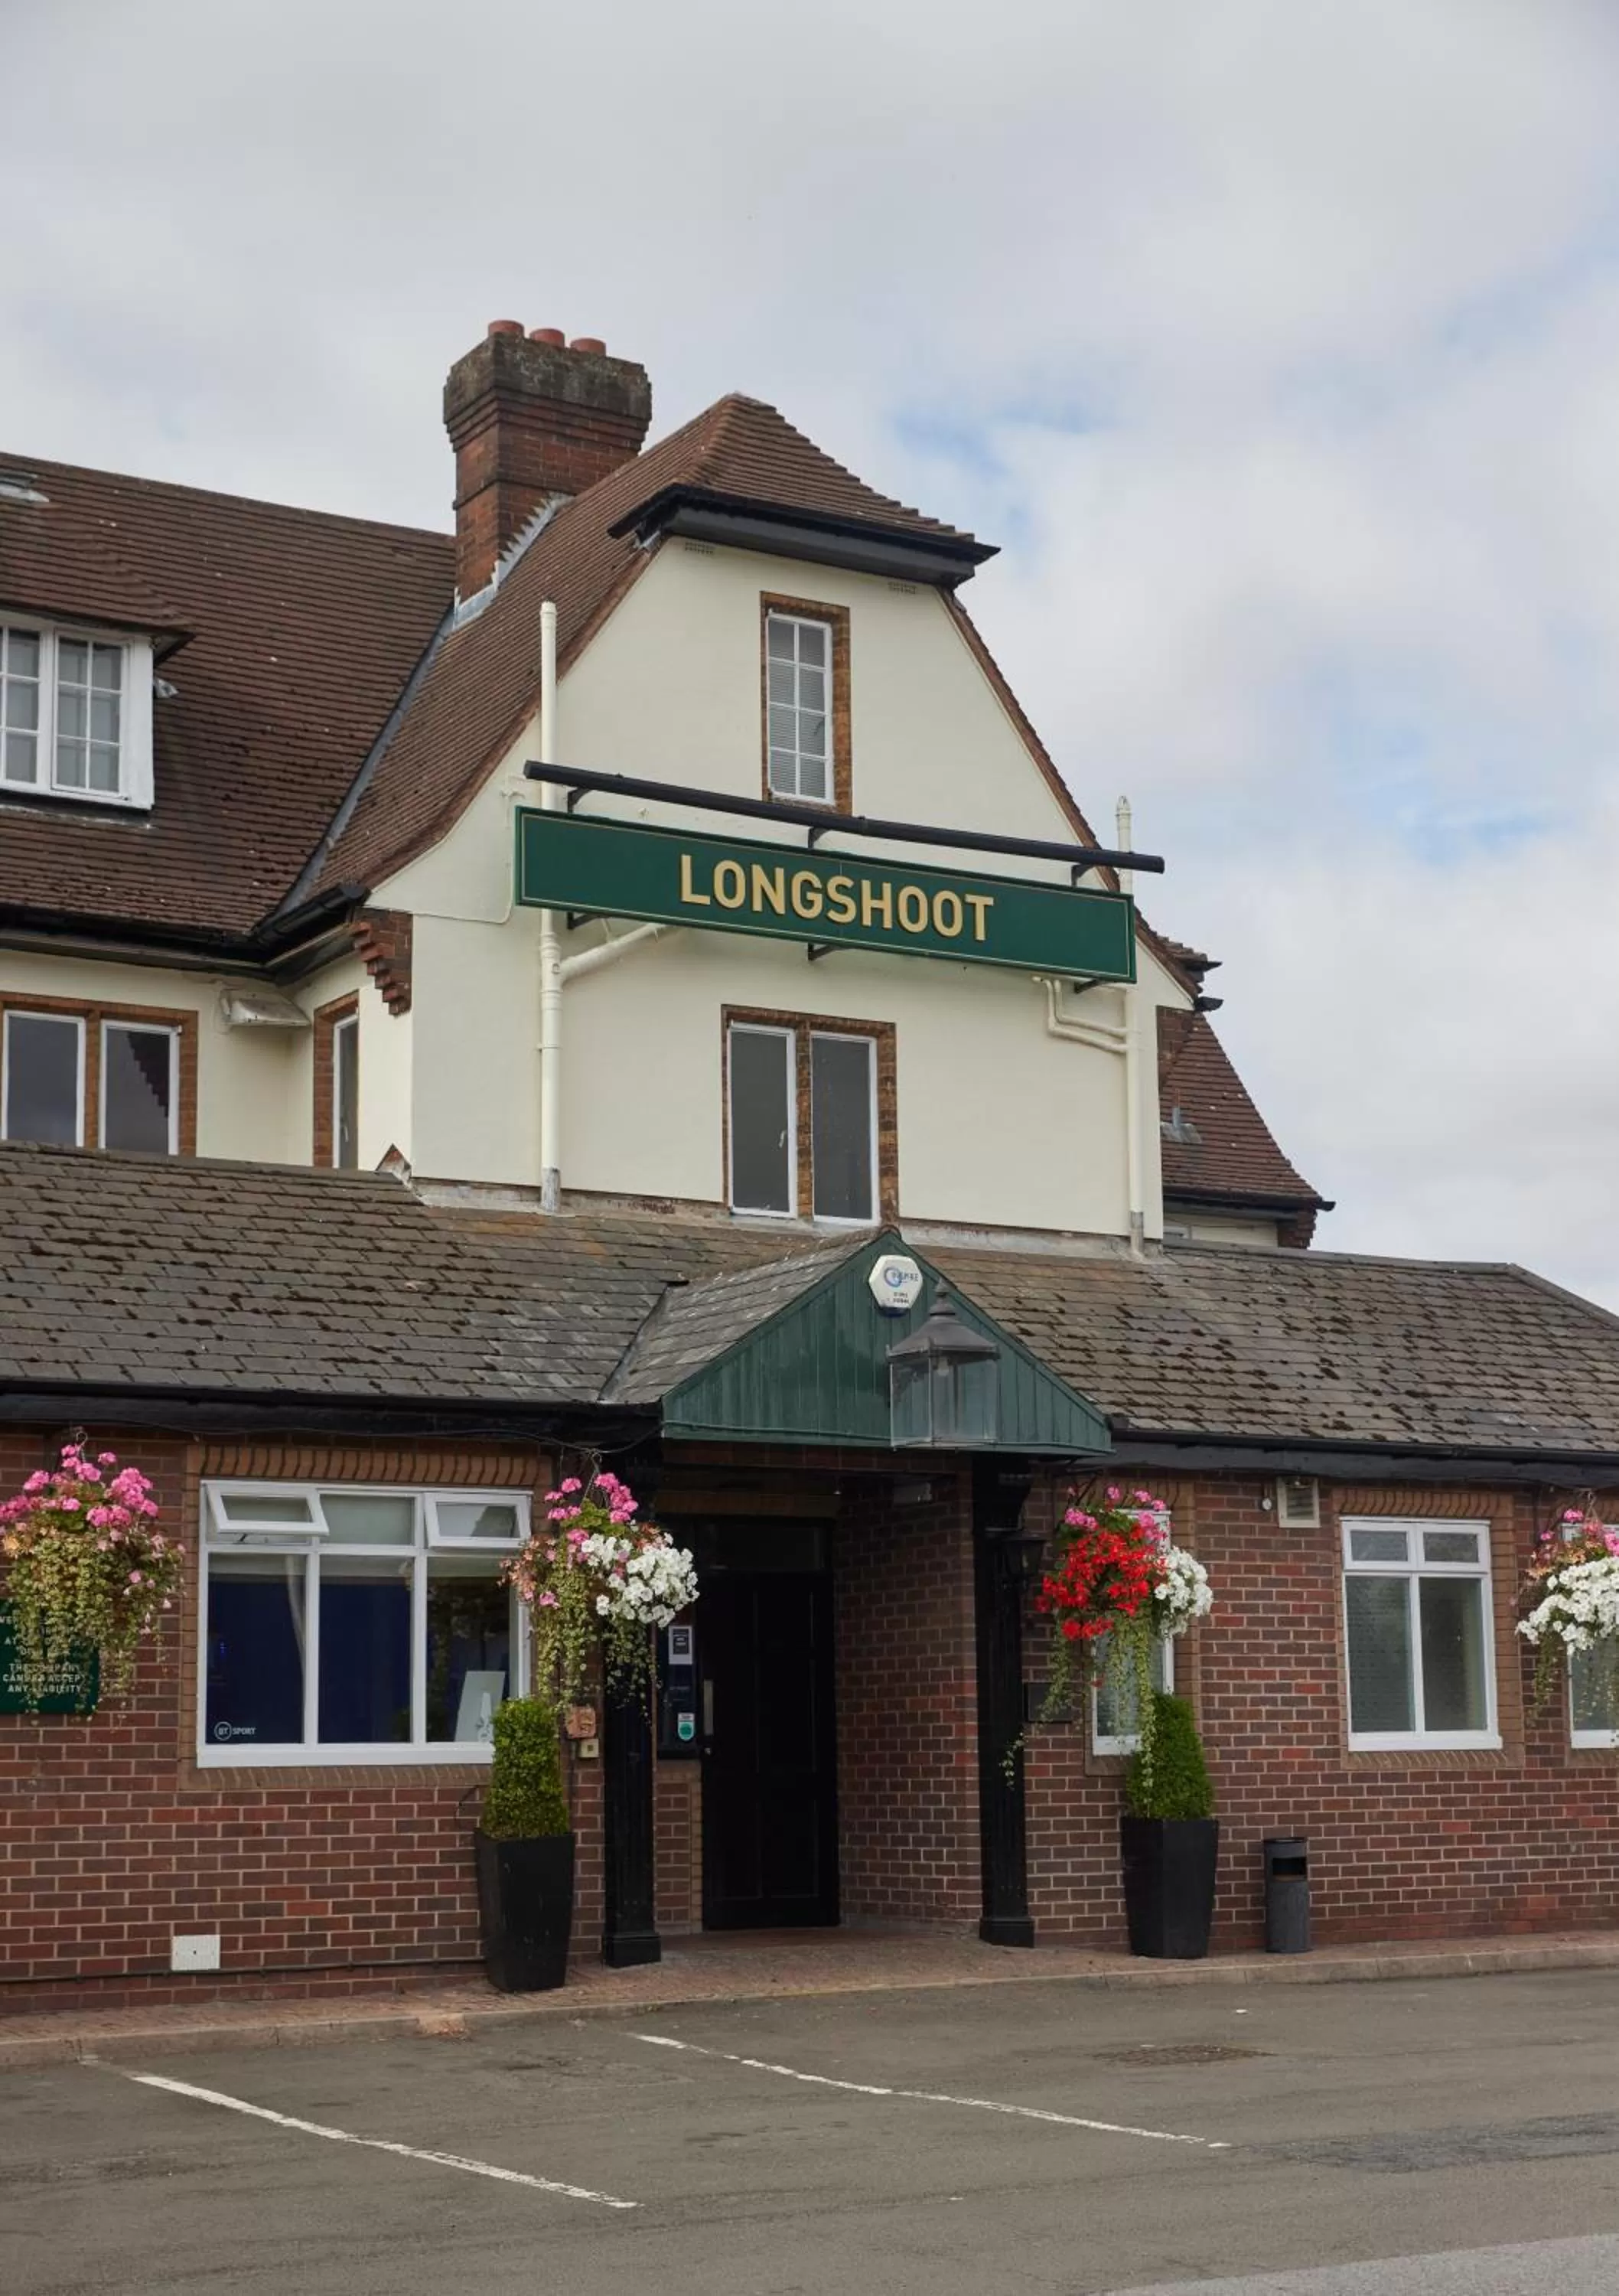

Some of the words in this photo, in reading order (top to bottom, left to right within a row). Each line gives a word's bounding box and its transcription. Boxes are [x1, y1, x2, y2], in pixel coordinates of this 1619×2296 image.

[679, 853, 994, 941] LONGSHOOT
[32, 1662, 80, 1673] CPANY
[2, 1674, 45, 1682] CAN
[8, 1684, 28, 1693] ANY
[32, 1684, 81, 1694] ABILITY
[232, 1727, 256, 1735] SPORT
